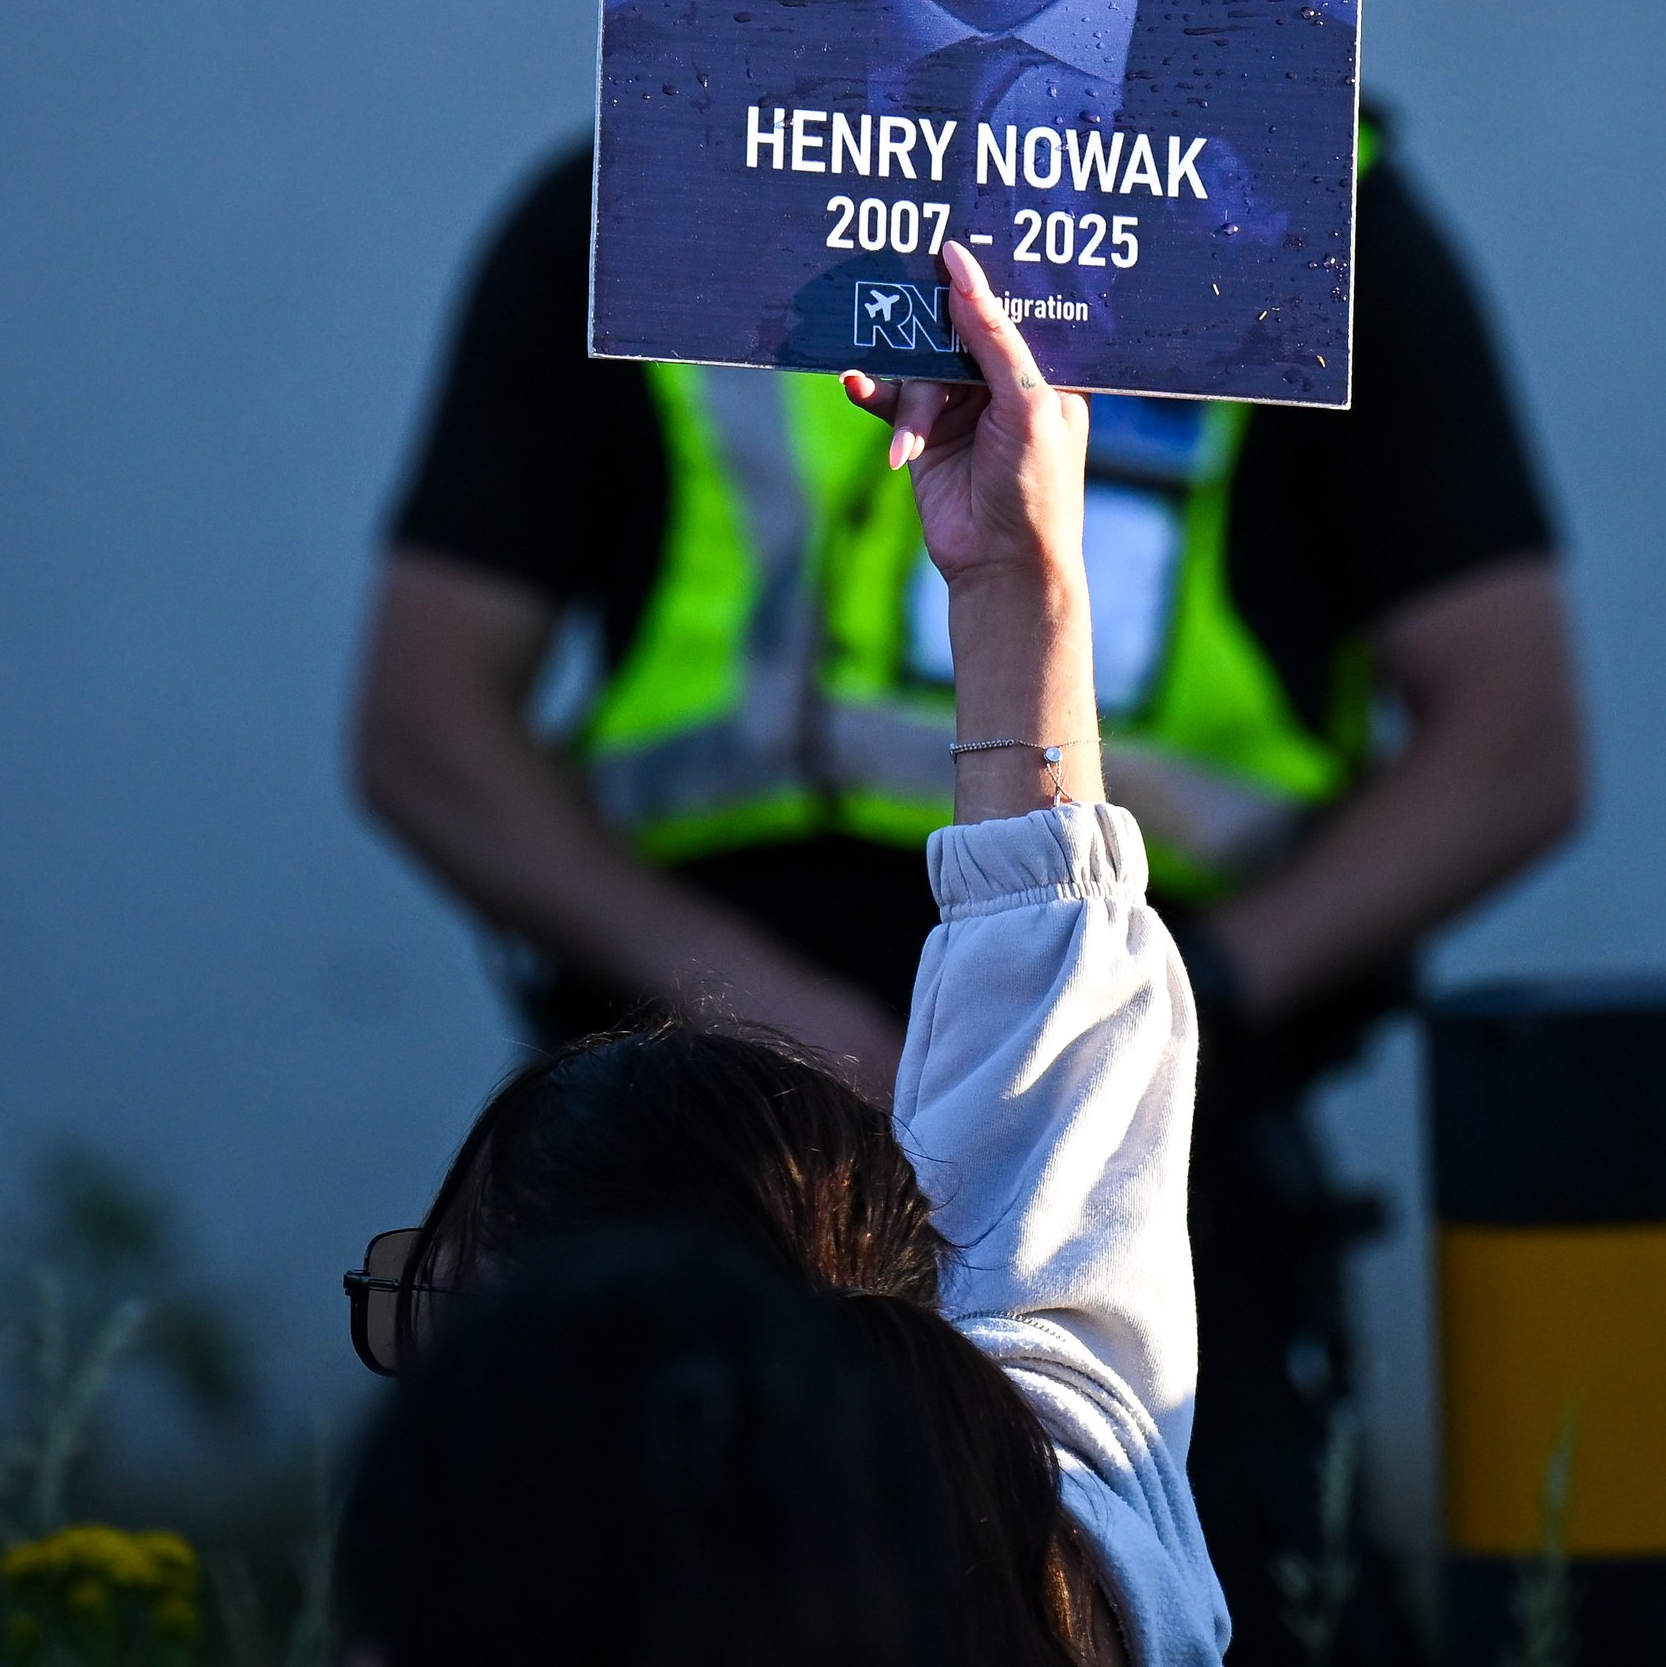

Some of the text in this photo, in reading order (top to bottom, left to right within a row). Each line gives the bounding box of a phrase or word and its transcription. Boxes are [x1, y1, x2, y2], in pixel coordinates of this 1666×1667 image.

[746, 105, 1208, 200] HENRY NOWAK
[826, 194, 951, 256] 2007
[1012, 208, 1139, 269] 2025
